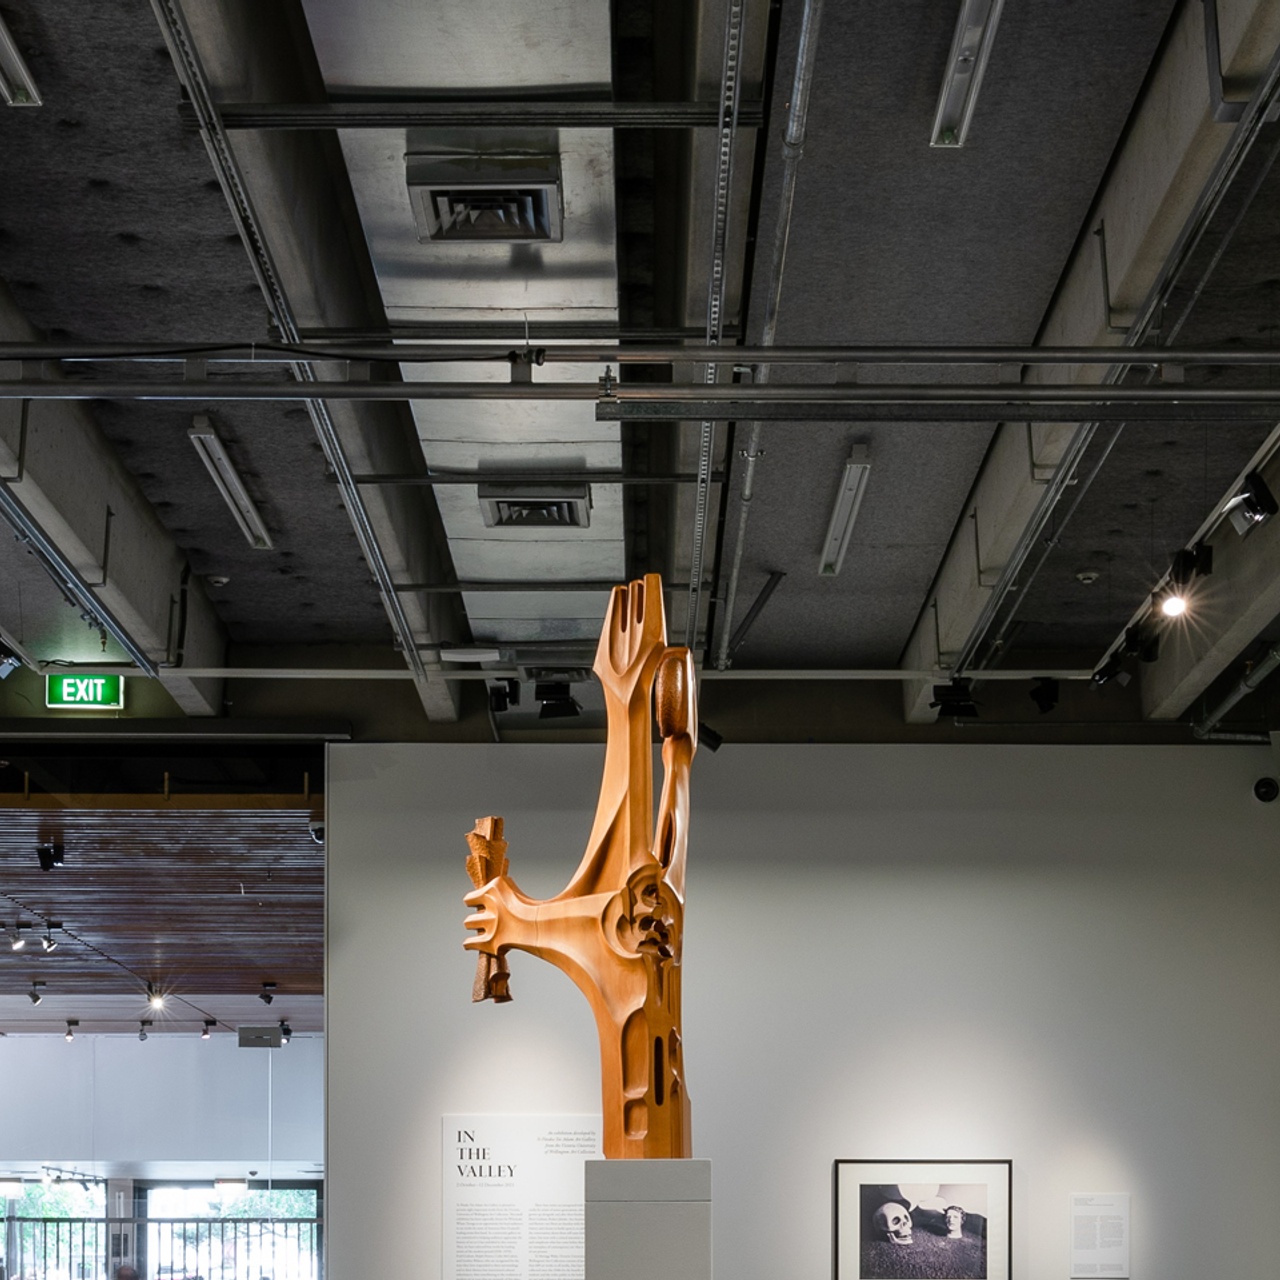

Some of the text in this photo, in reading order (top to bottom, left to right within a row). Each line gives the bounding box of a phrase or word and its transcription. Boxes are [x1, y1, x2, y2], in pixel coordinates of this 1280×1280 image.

[62, 678, 106, 702] EXIT
[457, 1130, 475, 1143] IN
[456, 1147, 491, 1160] THE
[456, 1164, 517, 1178] VALLEY
